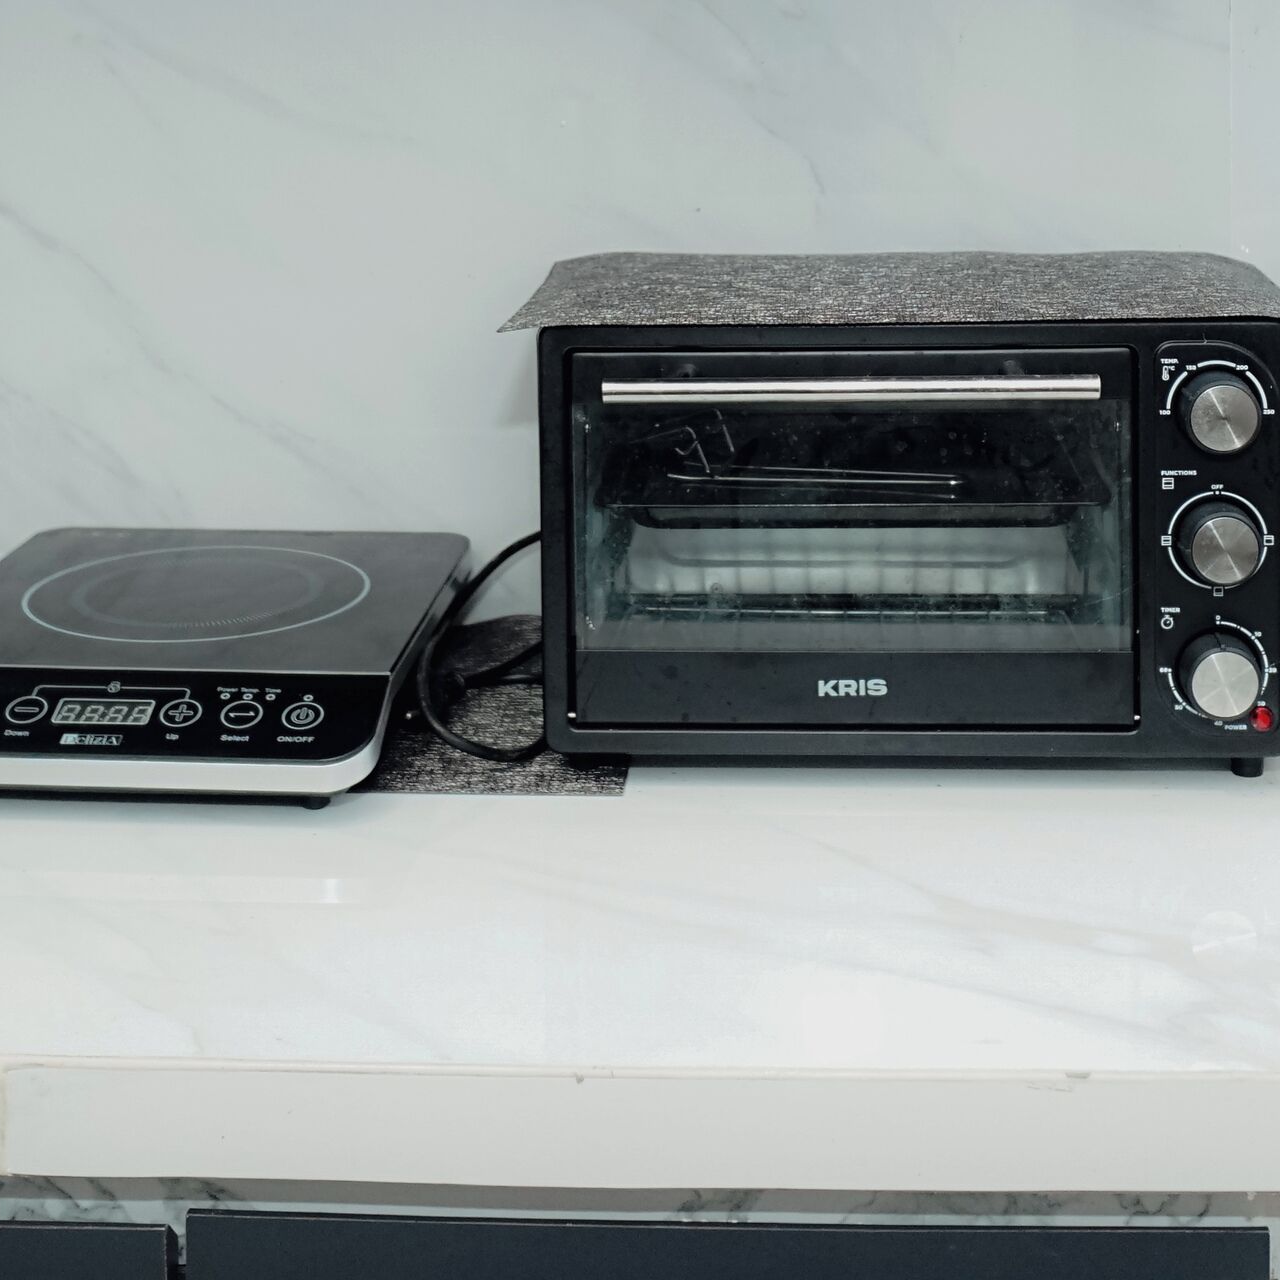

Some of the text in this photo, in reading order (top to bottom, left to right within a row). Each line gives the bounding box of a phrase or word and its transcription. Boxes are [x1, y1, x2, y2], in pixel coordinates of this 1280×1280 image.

[817, 678, 888, 697] KRIS
[4, 729, 29, 737] Down
[165, 733, 179, 741] Up
[220, 734, 250, 742] Select
[276, 735, 315, 743] ON/OFF
